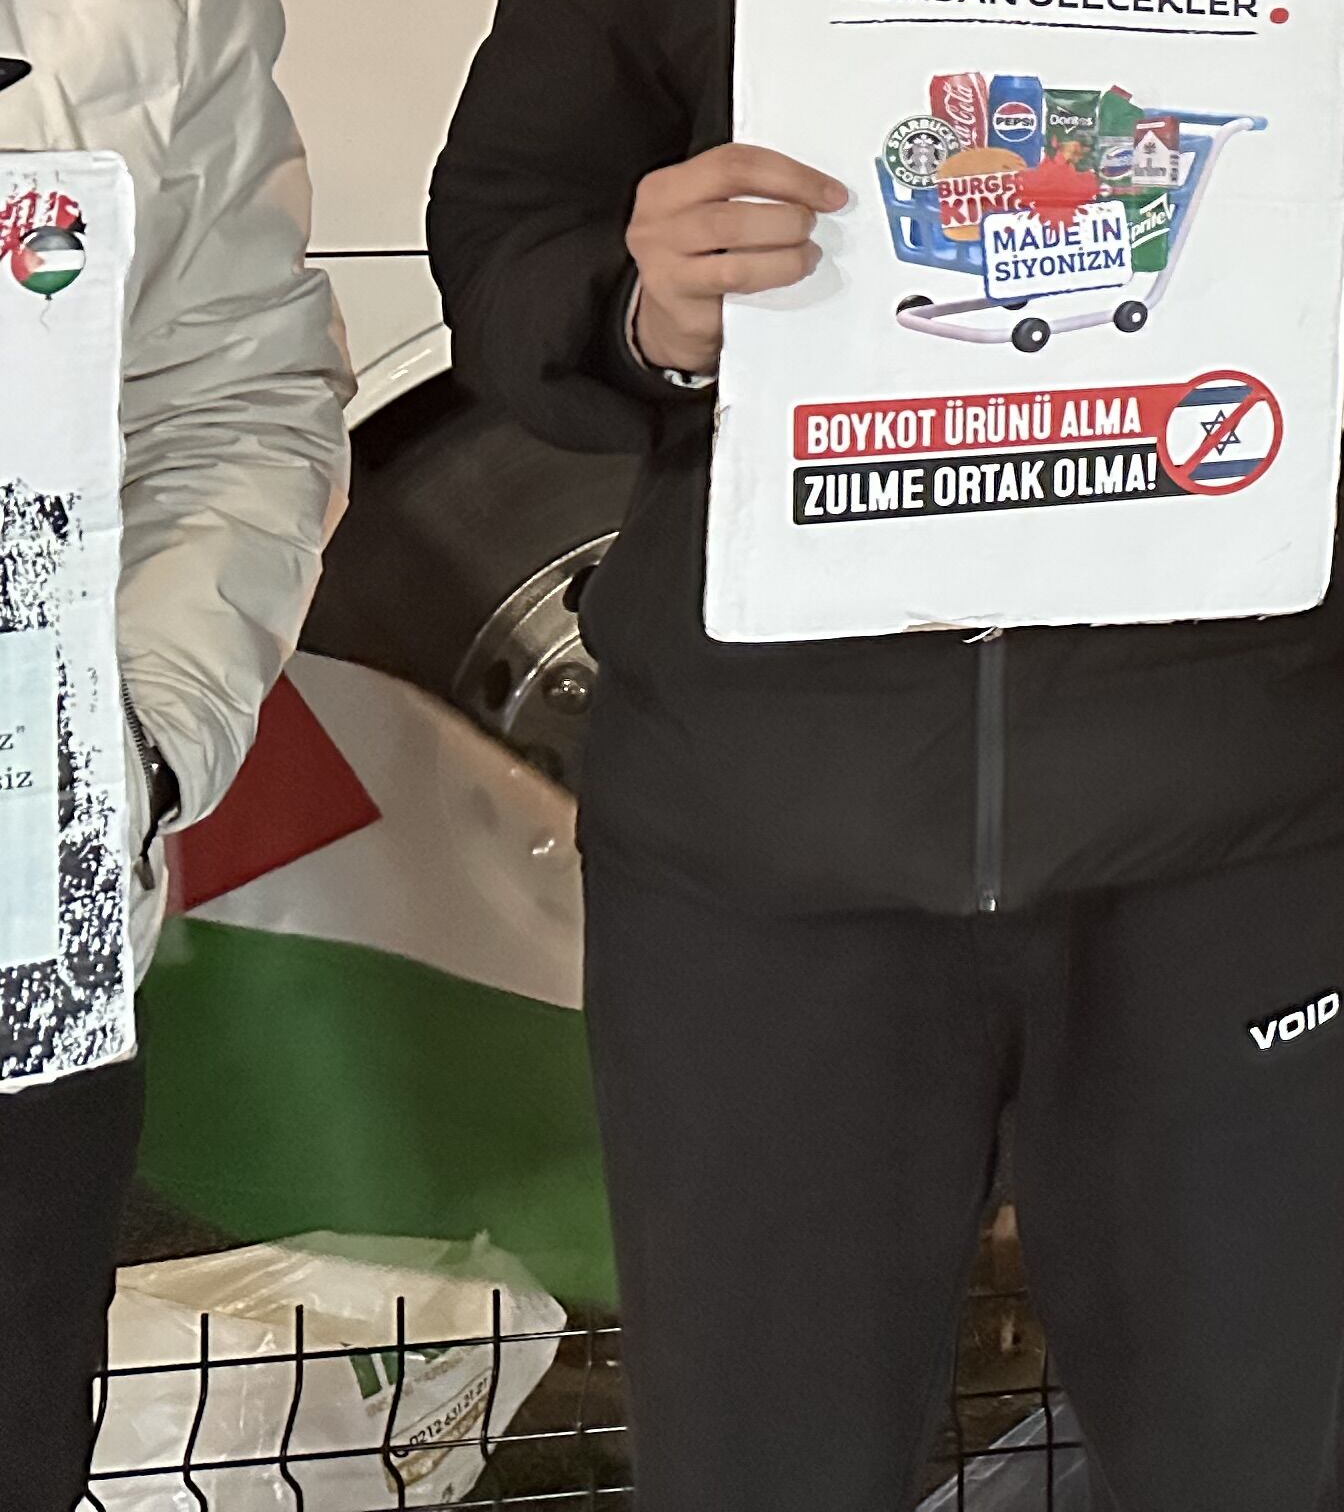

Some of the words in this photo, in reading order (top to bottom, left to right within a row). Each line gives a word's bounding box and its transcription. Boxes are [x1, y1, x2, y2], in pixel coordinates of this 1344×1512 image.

[887, 118, 960, 150] STARBUCKS
[996, 116, 1034, 127] PEPSI
[1049, 114, 1093, 126] Doritos
[992, 222, 1080, 254] MADE
[1091, 217, 1123, 245] IN
[994, 245, 1127, 282] SİYONİZM
[807, 409, 937, 455] BOYKOT
[943, 395, 1052, 446] ÜRÜNÜ
[1061, 396, 1142, 438] ALMA
[803, 466, 924, 516] ZULME
[932, 458, 1047, 506] ORTAK
[1052, 452, 1158, 498] OLMA!
[1249, 992, 1340, 1050] VOID
